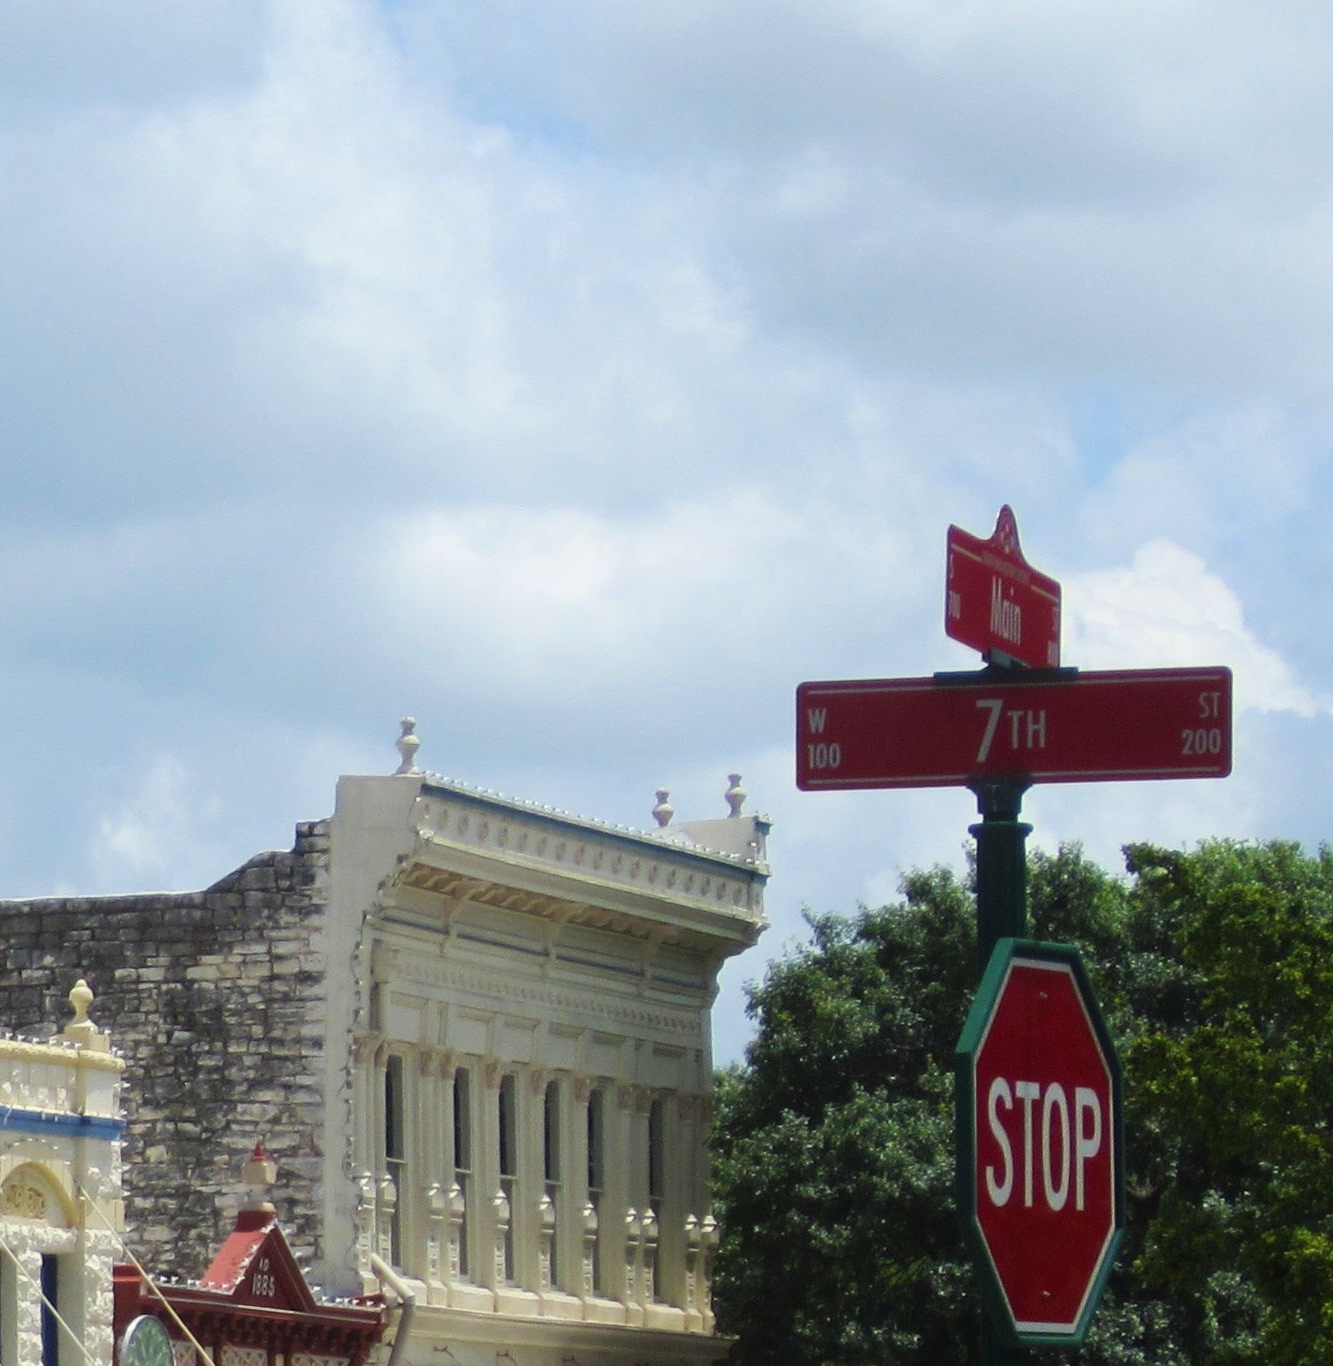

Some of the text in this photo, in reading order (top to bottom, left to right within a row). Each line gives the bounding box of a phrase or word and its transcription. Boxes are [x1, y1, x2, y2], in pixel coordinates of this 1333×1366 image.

[990, 575, 1021, 646] Main
[1199, 692, 1221, 719] ST
[807, 708, 827, 734] W
[975, 699, 1046, 763] 7TH
[807, 743, 841, 769] 100
[1181, 730, 1221, 756] 200
[986, 1076, 1102, 1212] STOP
